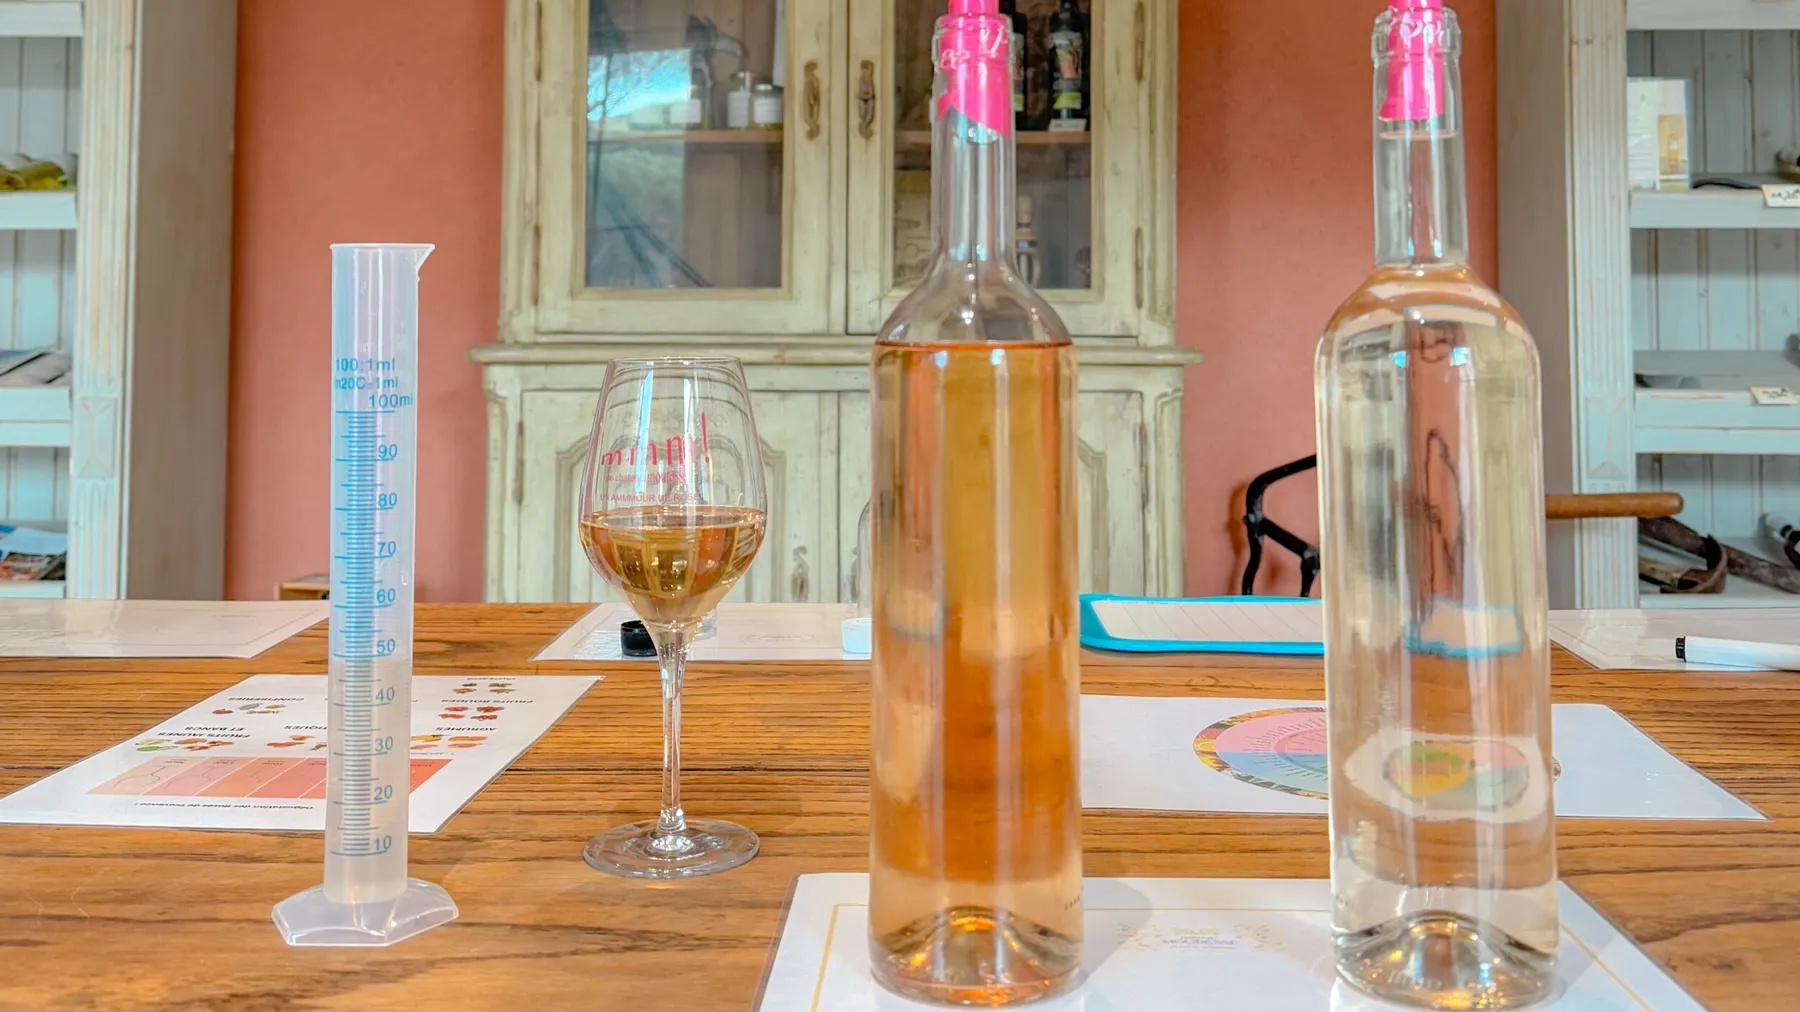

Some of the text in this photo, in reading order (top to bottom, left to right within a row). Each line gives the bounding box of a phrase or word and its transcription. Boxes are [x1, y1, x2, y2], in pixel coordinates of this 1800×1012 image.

[368, 393, 413, 408] 100ml
[377, 444, 398, 458] 90
[377, 493, 398, 507] 80
[376, 541, 397, 555] 70
[375, 588, 397, 602] 60
[375, 638, 396, 655] 50
[374, 687, 395, 702] 40
[374, 736, 394, 752] 30
[373, 785, 393, 801] 20
[373, 836, 393, 851] 10
